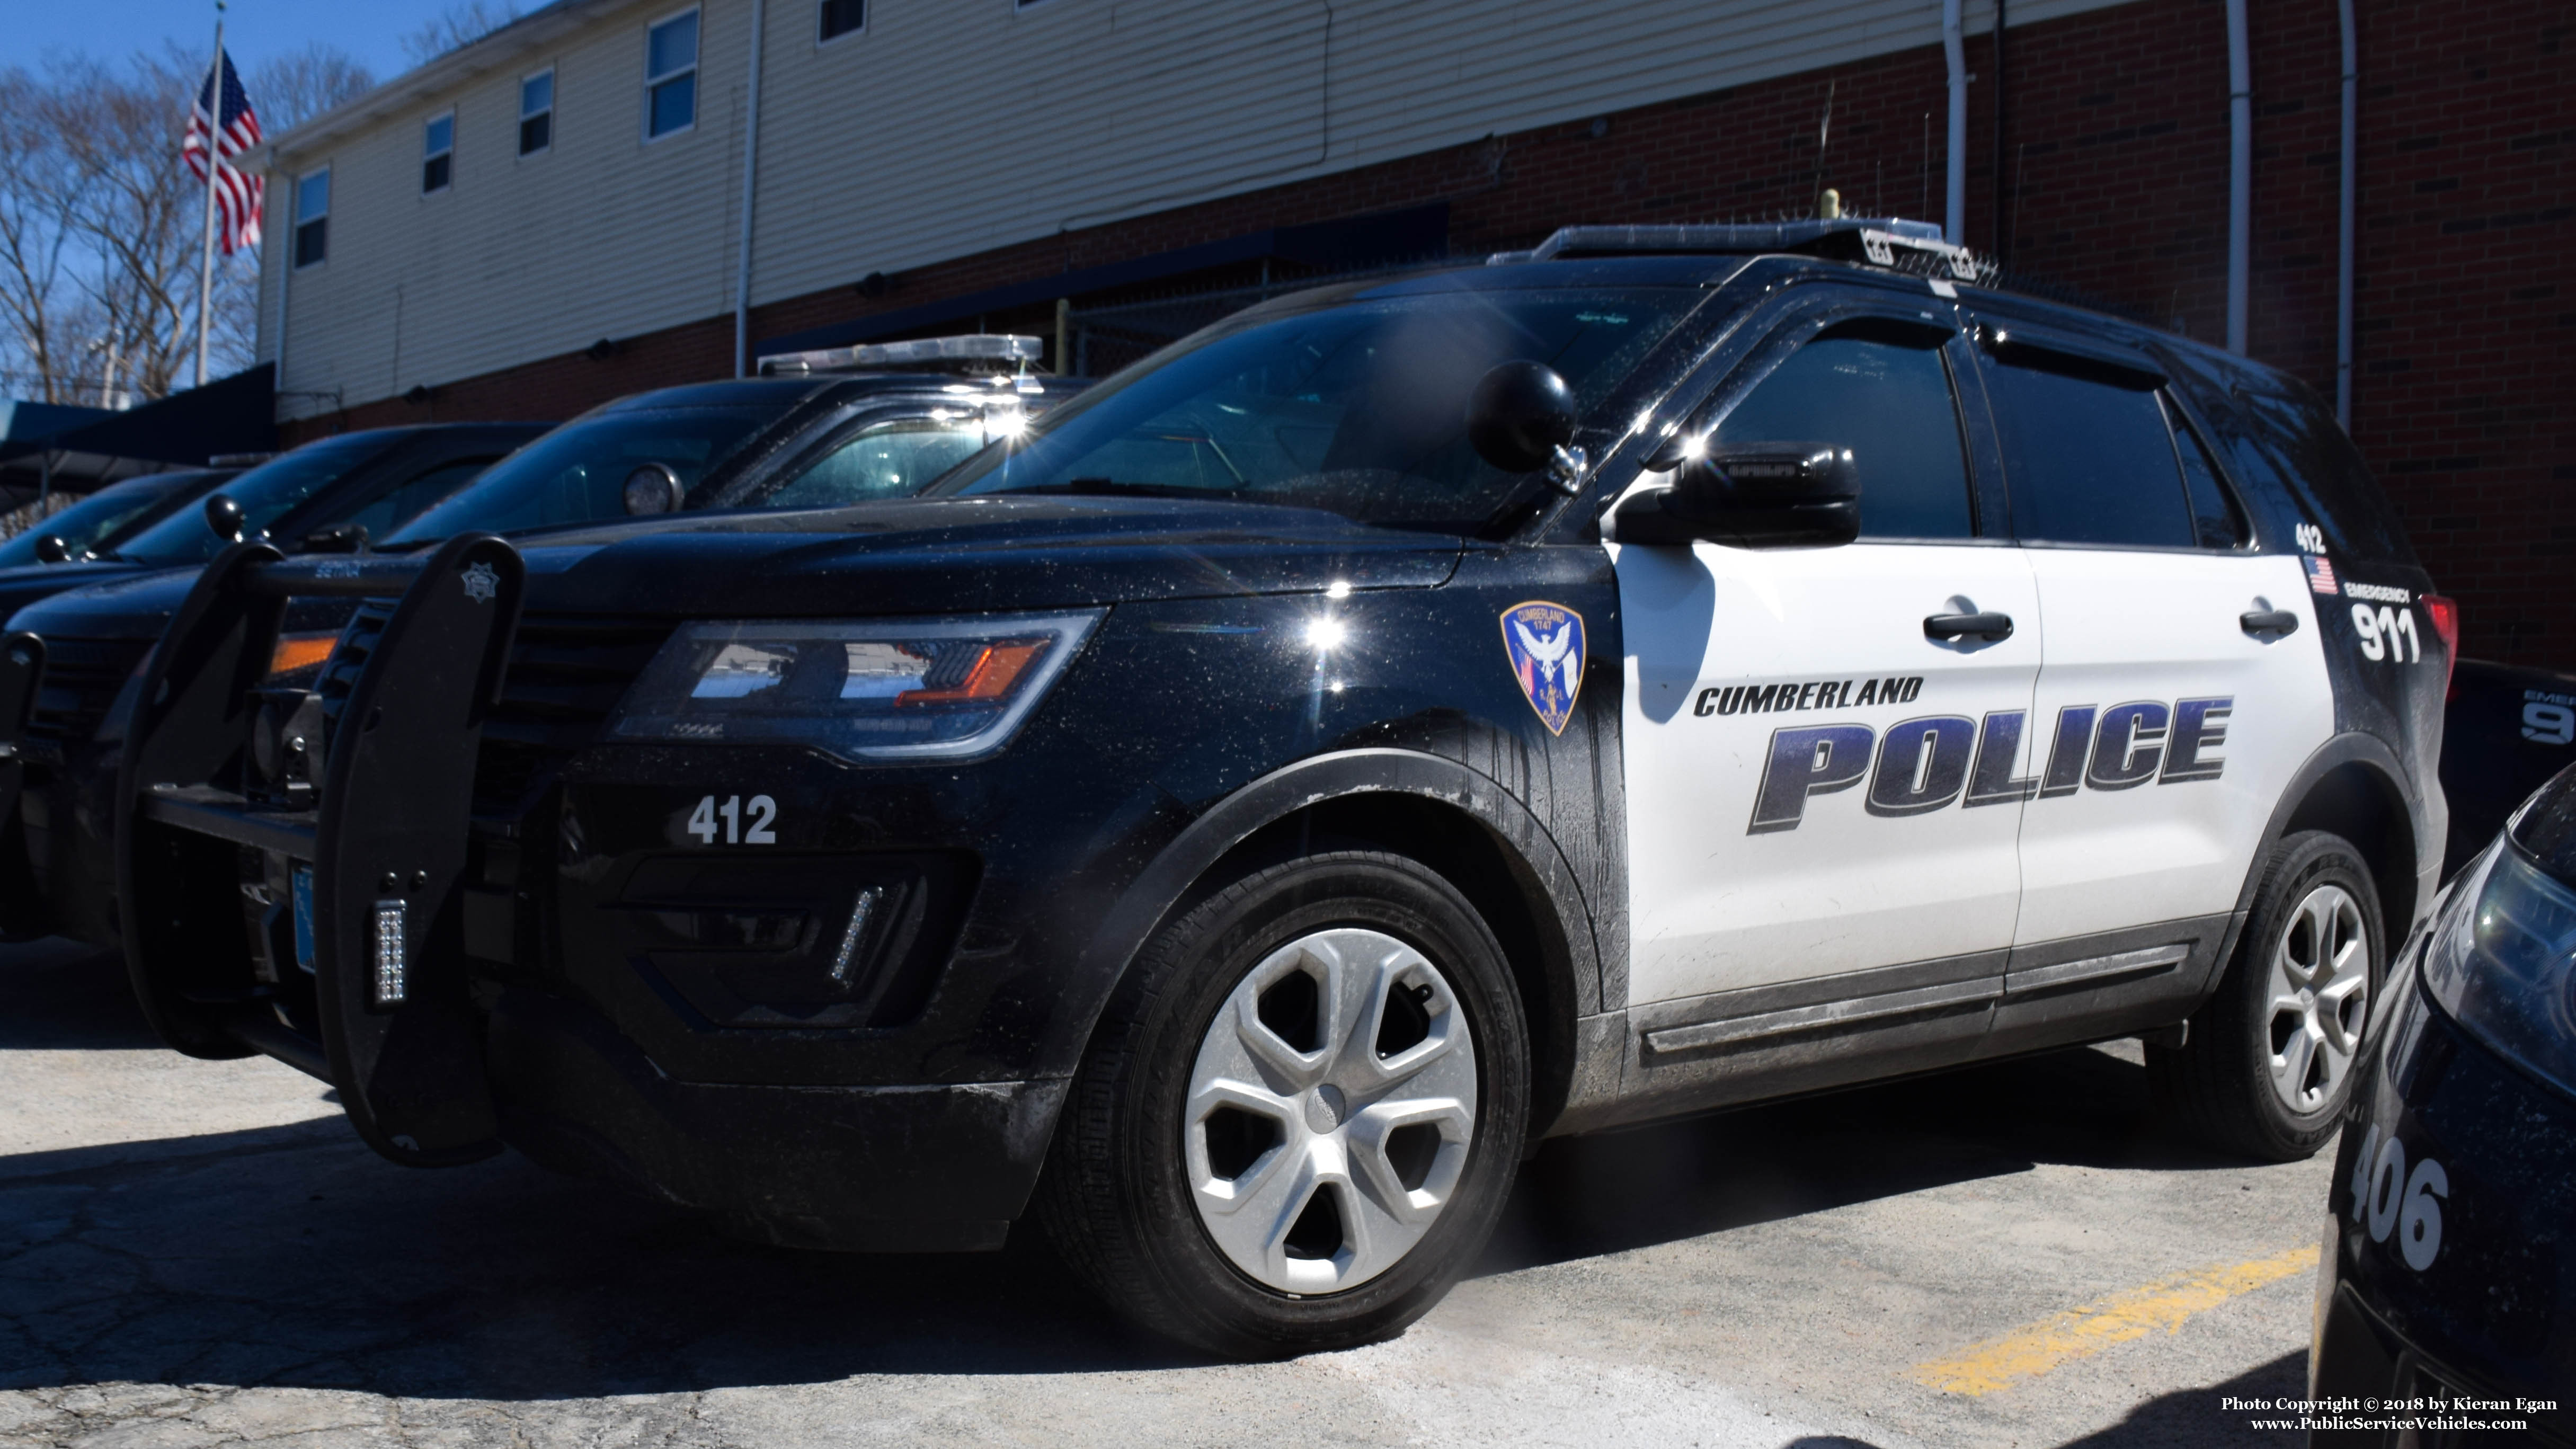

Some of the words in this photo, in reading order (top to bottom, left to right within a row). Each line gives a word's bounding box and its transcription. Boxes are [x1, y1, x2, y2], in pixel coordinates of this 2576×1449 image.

[2296, 522, 2326, 554] 412
[1517, 608, 1565, 623] CUMBERLAND
[1534, 620, 1552, 630] 1747
[2351, 603, 2420, 664] 911
[1693, 677, 1924, 717] CUMBERLAND
[1746, 695, 2234, 836] POLICE
[688, 794, 776, 844] 412
[2351, 1123, 2448, 1271] 406
